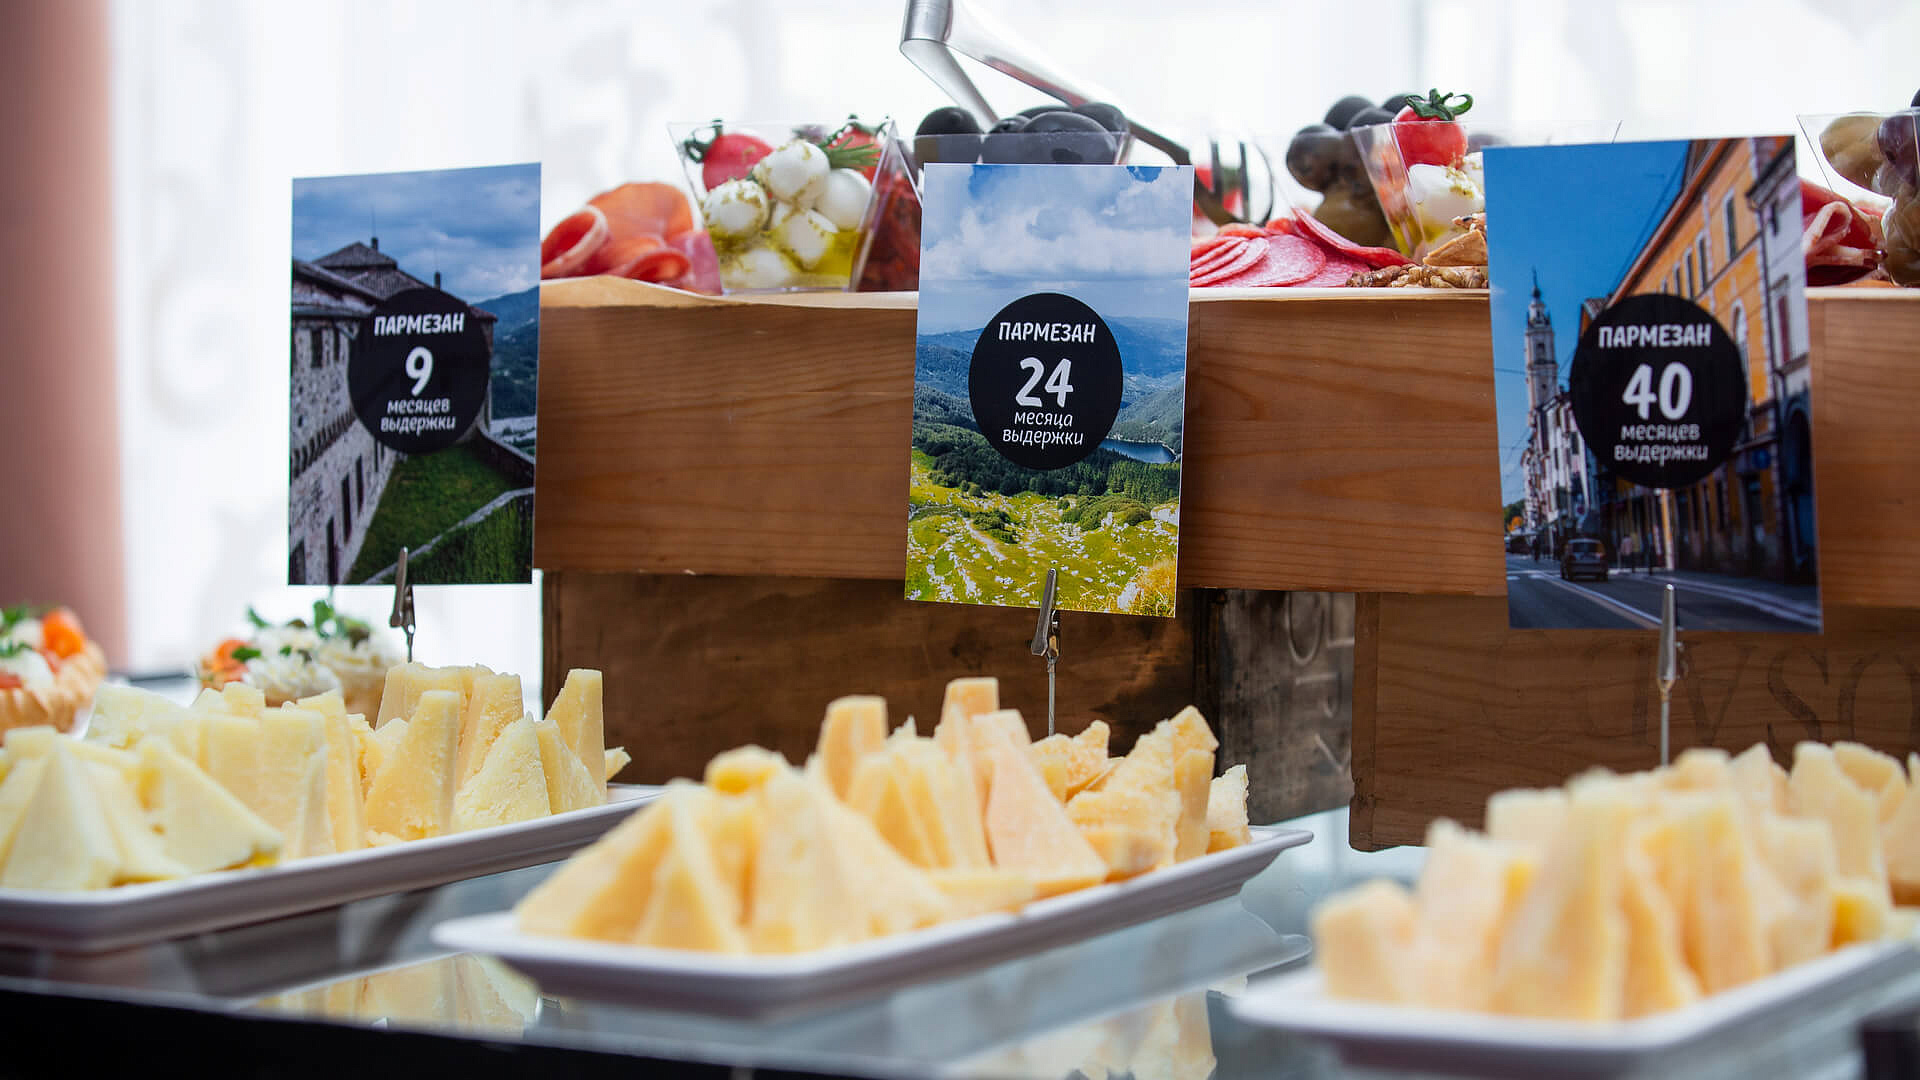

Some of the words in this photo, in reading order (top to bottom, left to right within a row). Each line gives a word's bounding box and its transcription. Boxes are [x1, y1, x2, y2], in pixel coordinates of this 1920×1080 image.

[374, 312, 465, 336] ПАРМЕЗАН
[998, 322, 1096, 343] ПАРМЕЗАН
[1597, 322, 1711, 348] ПАРМЕЗАН
[405, 346, 434, 397] 9
[1015, 357, 1073, 408] 24
[1622, 361, 1693, 420] 40
[387, 399, 450, 415] месяцев
[380, 416, 456, 437] выдержки
[1014, 412, 1073, 429] месяца
[1002, 429, 1083, 450] выдержки
[1621, 423, 1700, 443] месяцев
[1614, 444, 1709, 467] выдержки
